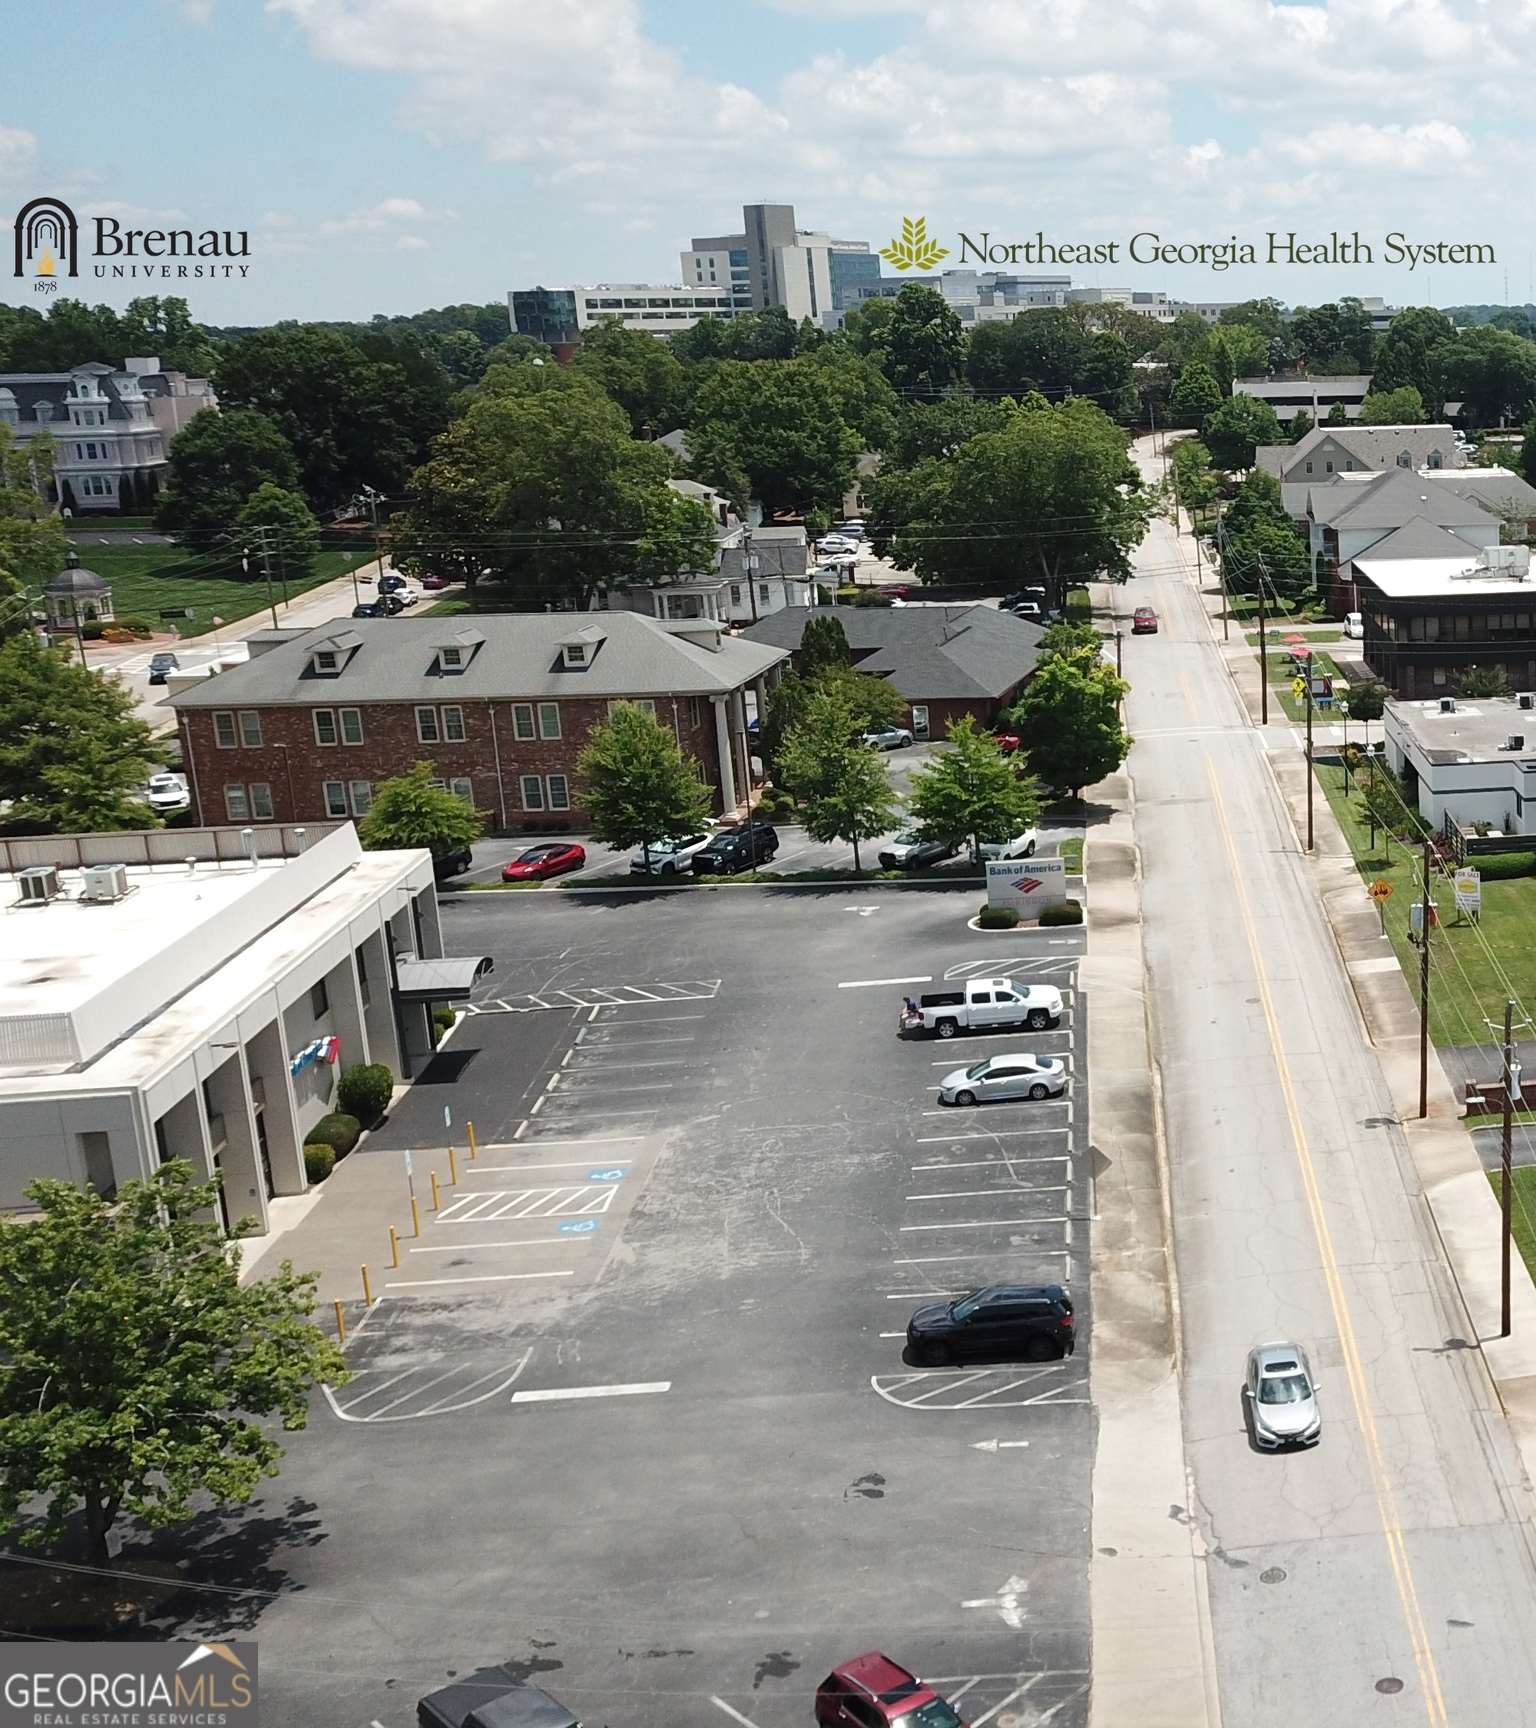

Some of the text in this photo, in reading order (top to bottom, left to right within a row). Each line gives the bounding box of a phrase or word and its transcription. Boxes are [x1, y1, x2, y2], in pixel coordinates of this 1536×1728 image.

[989, 864, 1061, 875] Bank of America
